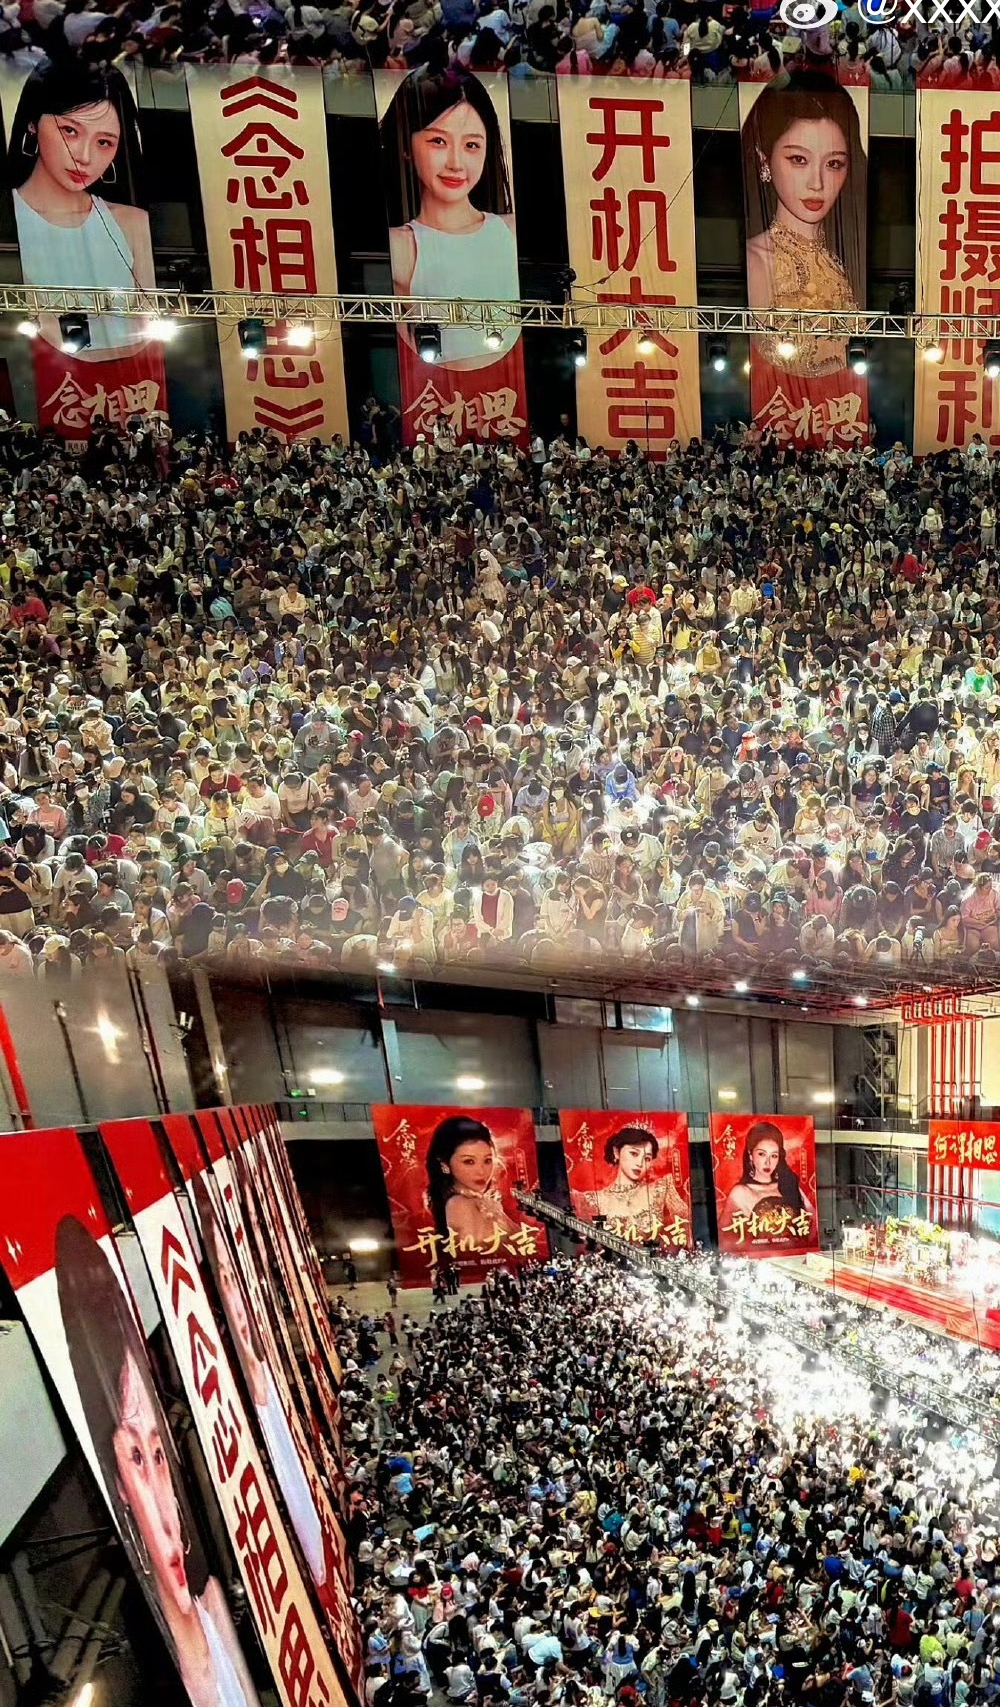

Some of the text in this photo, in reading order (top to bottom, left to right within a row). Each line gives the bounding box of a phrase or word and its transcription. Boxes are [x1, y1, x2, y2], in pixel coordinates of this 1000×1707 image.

[586, 97, 679, 439] 开机大吉
[753, 385, 868, 441] 念相思
[402, 1221, 540, 1268] 开机大吉
[604, 1213, 691, 1246] 机大吉
[722, 1208, 813, 1245] 开机大吉
